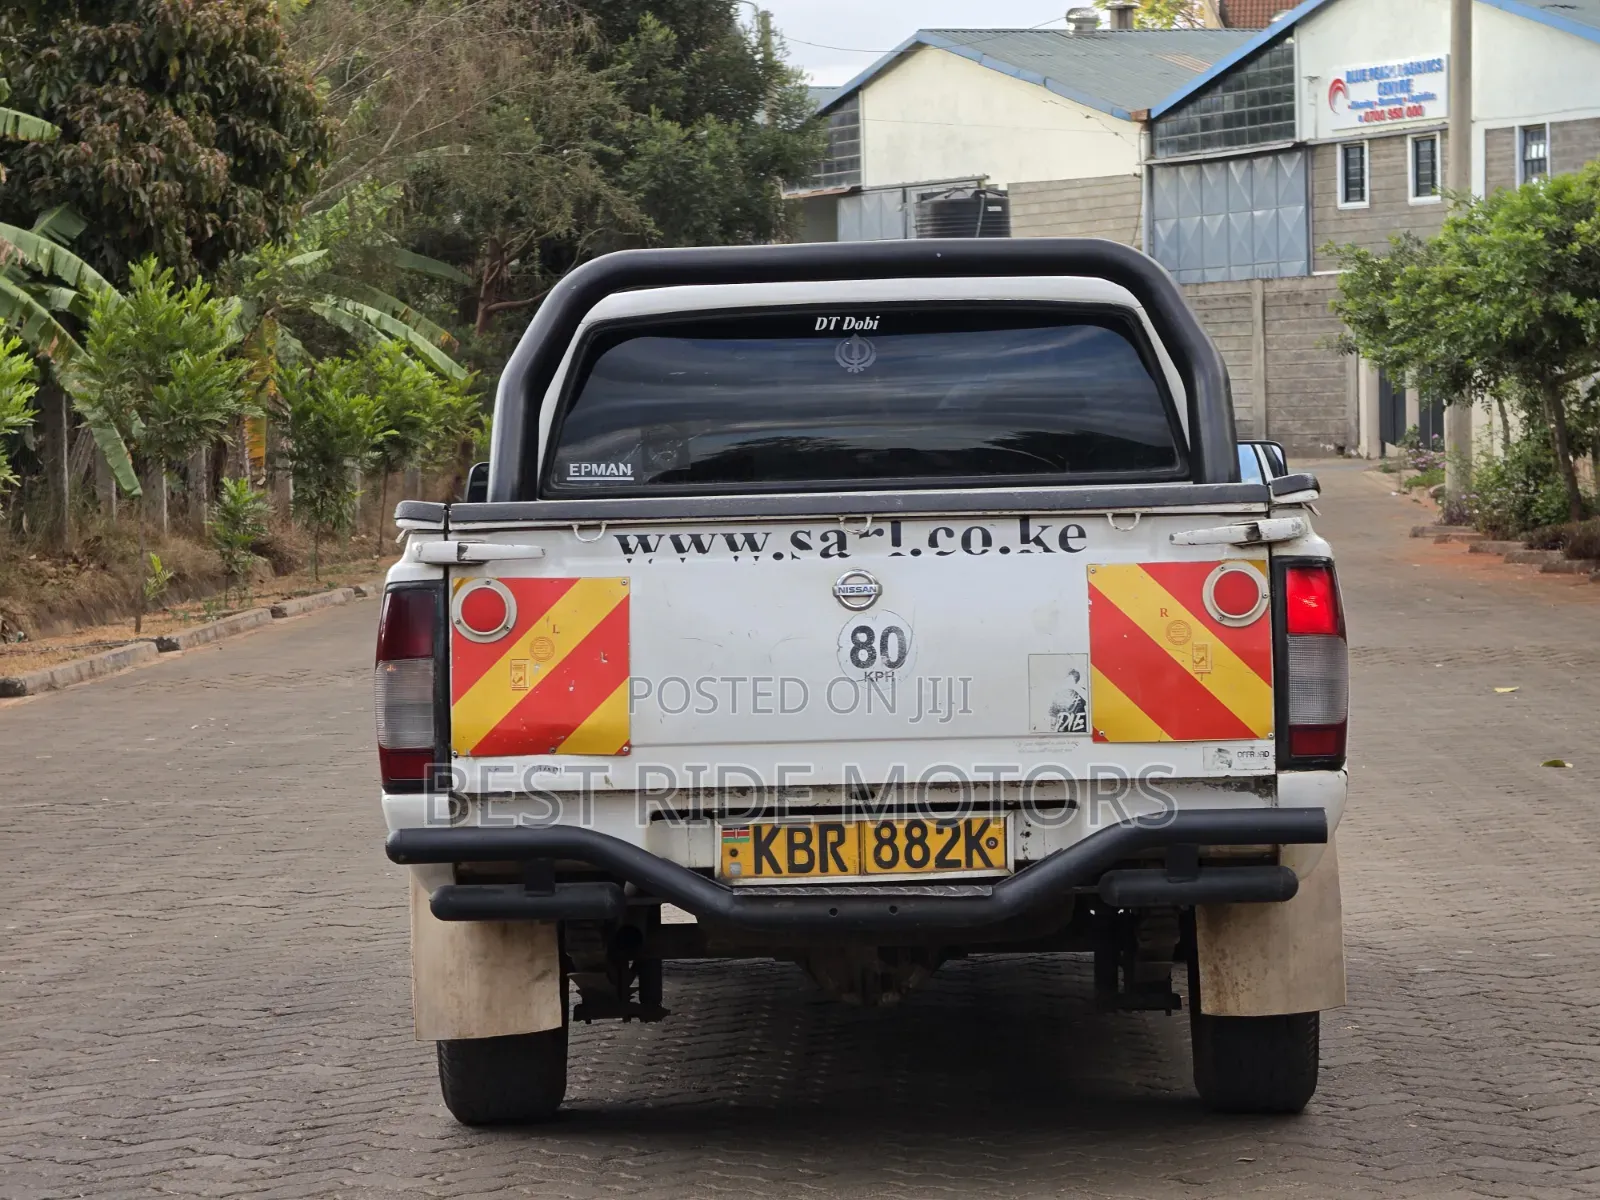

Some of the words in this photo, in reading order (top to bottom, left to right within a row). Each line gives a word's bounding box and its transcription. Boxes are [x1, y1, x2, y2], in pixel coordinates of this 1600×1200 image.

[815, 317, 840, 330] DT
[843, 315, 880, 330] Dobi
[569, 462, 633, 476] EPMAN
[838, 586, 877, 594] NISSAN
[1160, 607, 1169, 617] R
[850, 625, 907, 669] 80
[864, 671, 895, 682] KPH
[754, 823, 848, 875] KBR
[873, 818, 994, 870] 882K
